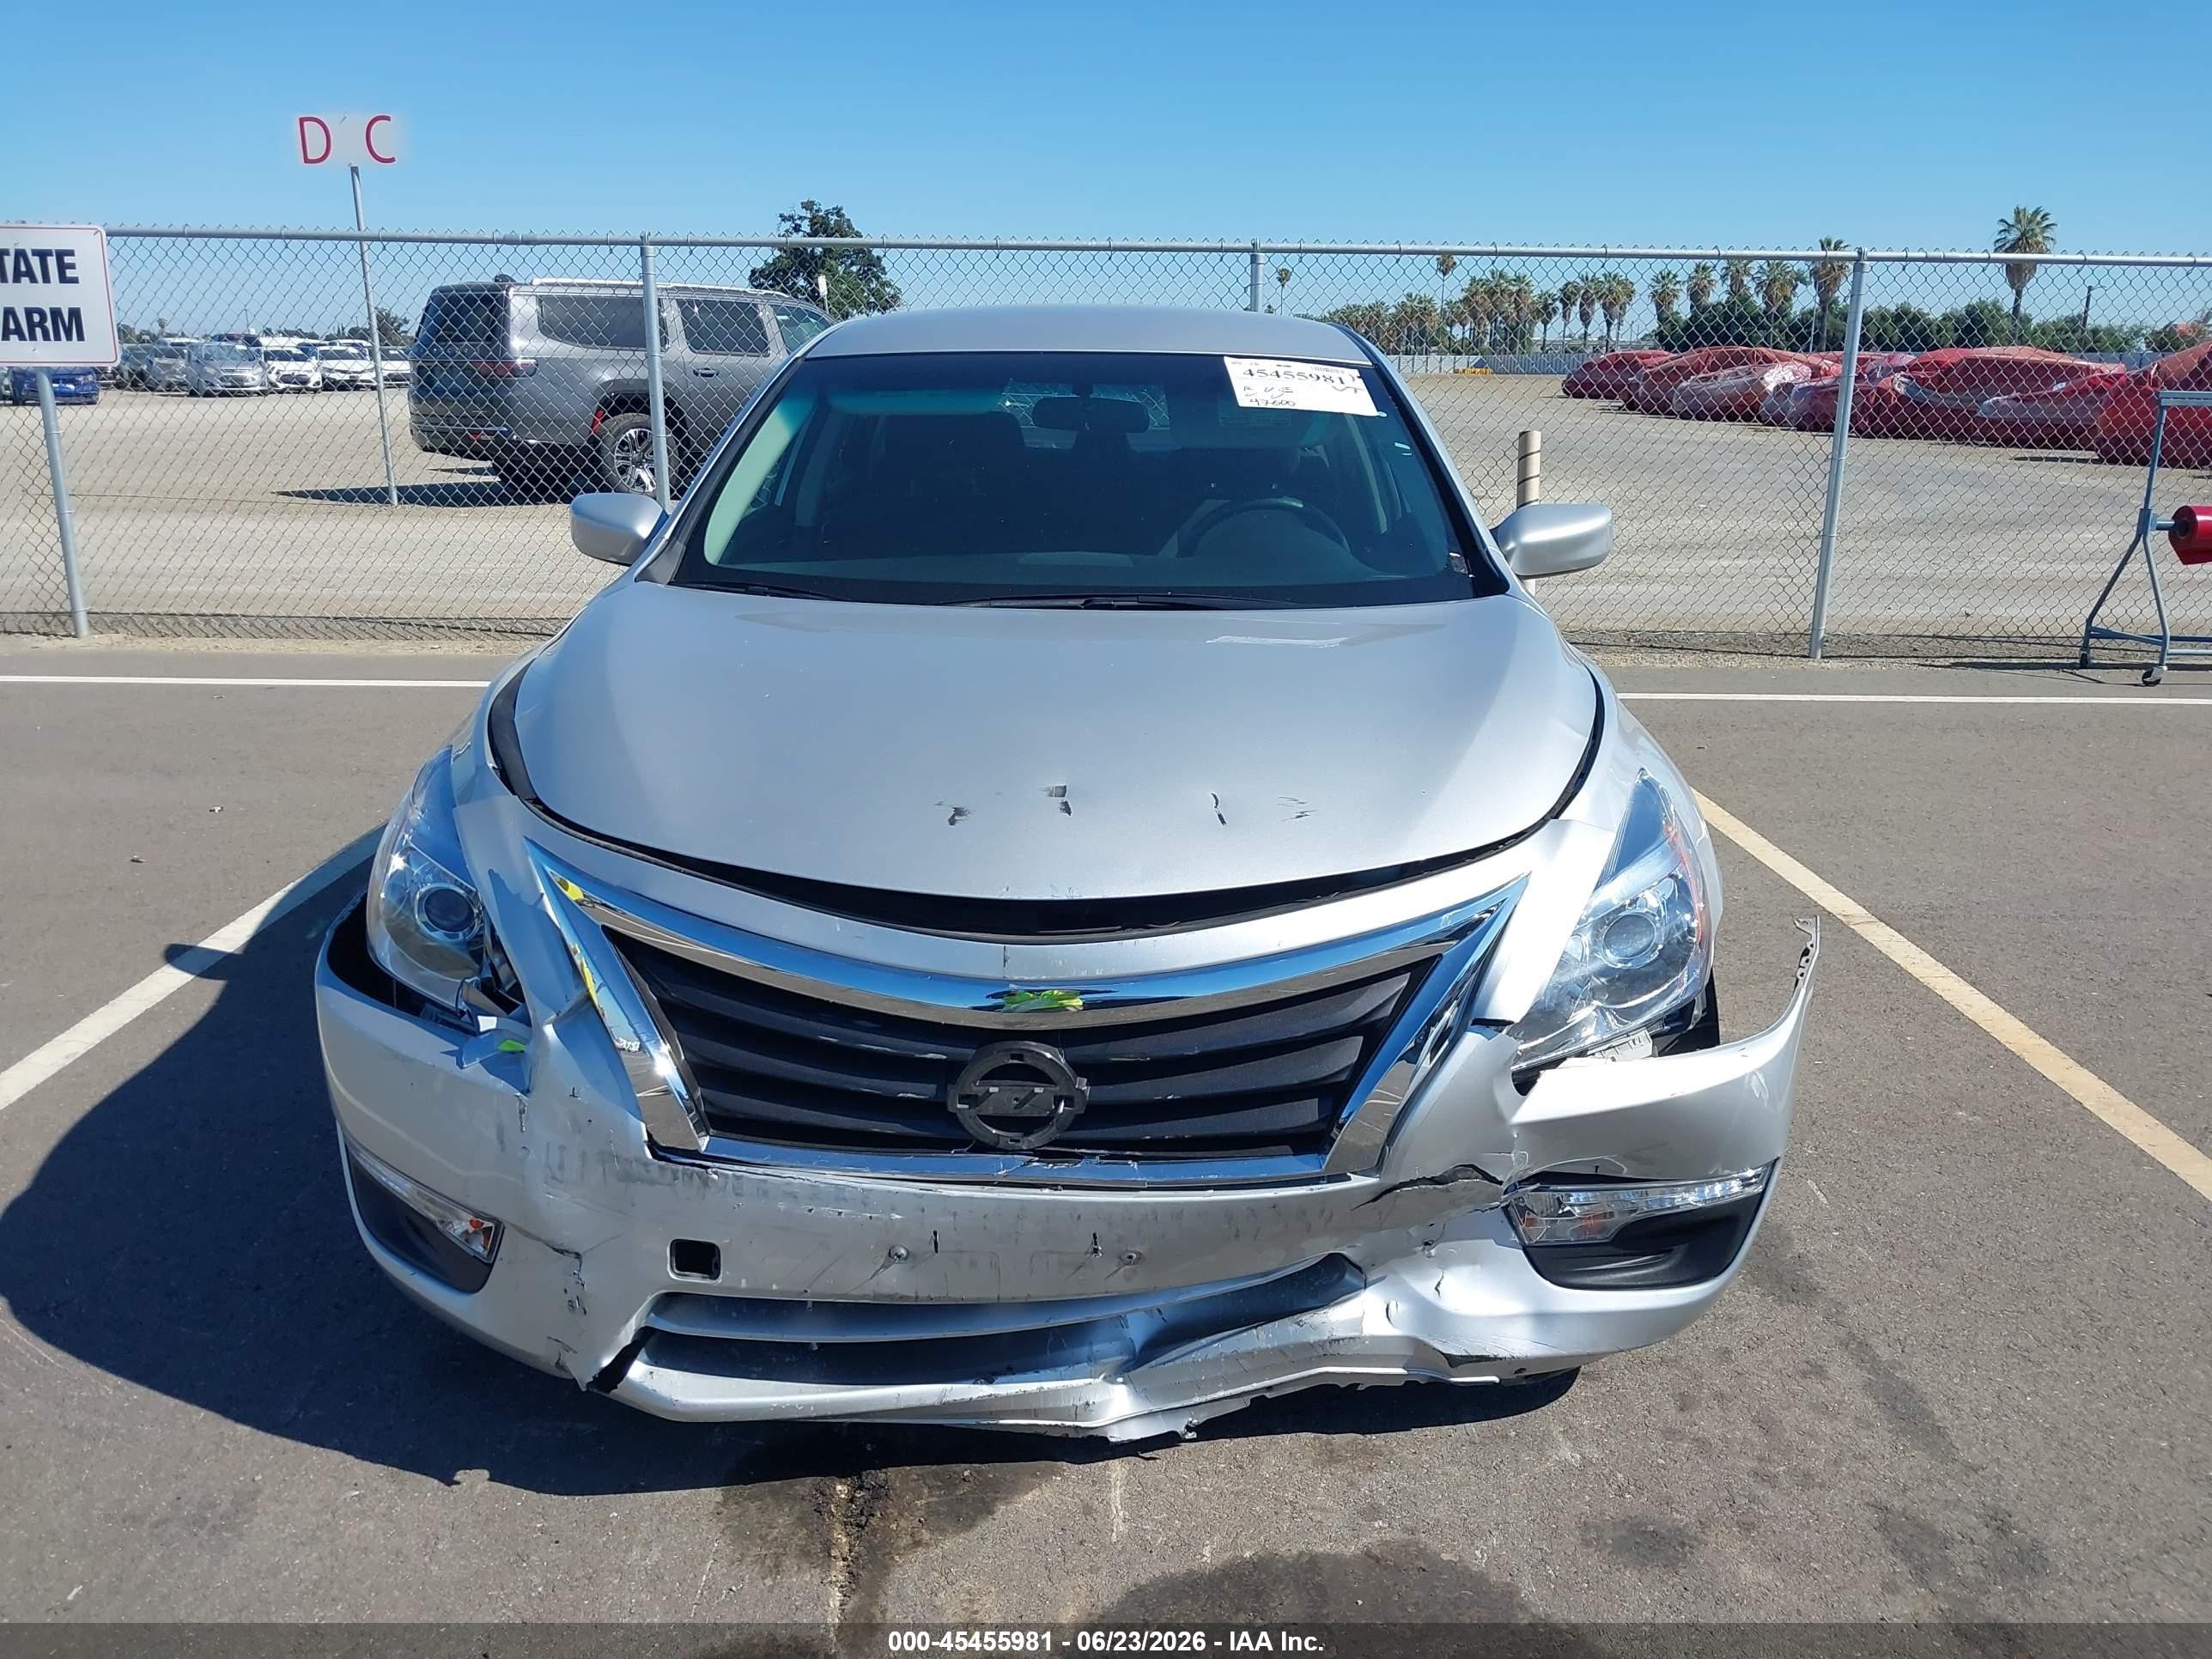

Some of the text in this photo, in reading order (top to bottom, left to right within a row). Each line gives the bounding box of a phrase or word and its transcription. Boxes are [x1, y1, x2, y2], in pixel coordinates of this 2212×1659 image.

[299, 115, 396, 164] D C
[1, 307, 85, 342] ARM
[1243, 368, 1346, 386] 45455981
